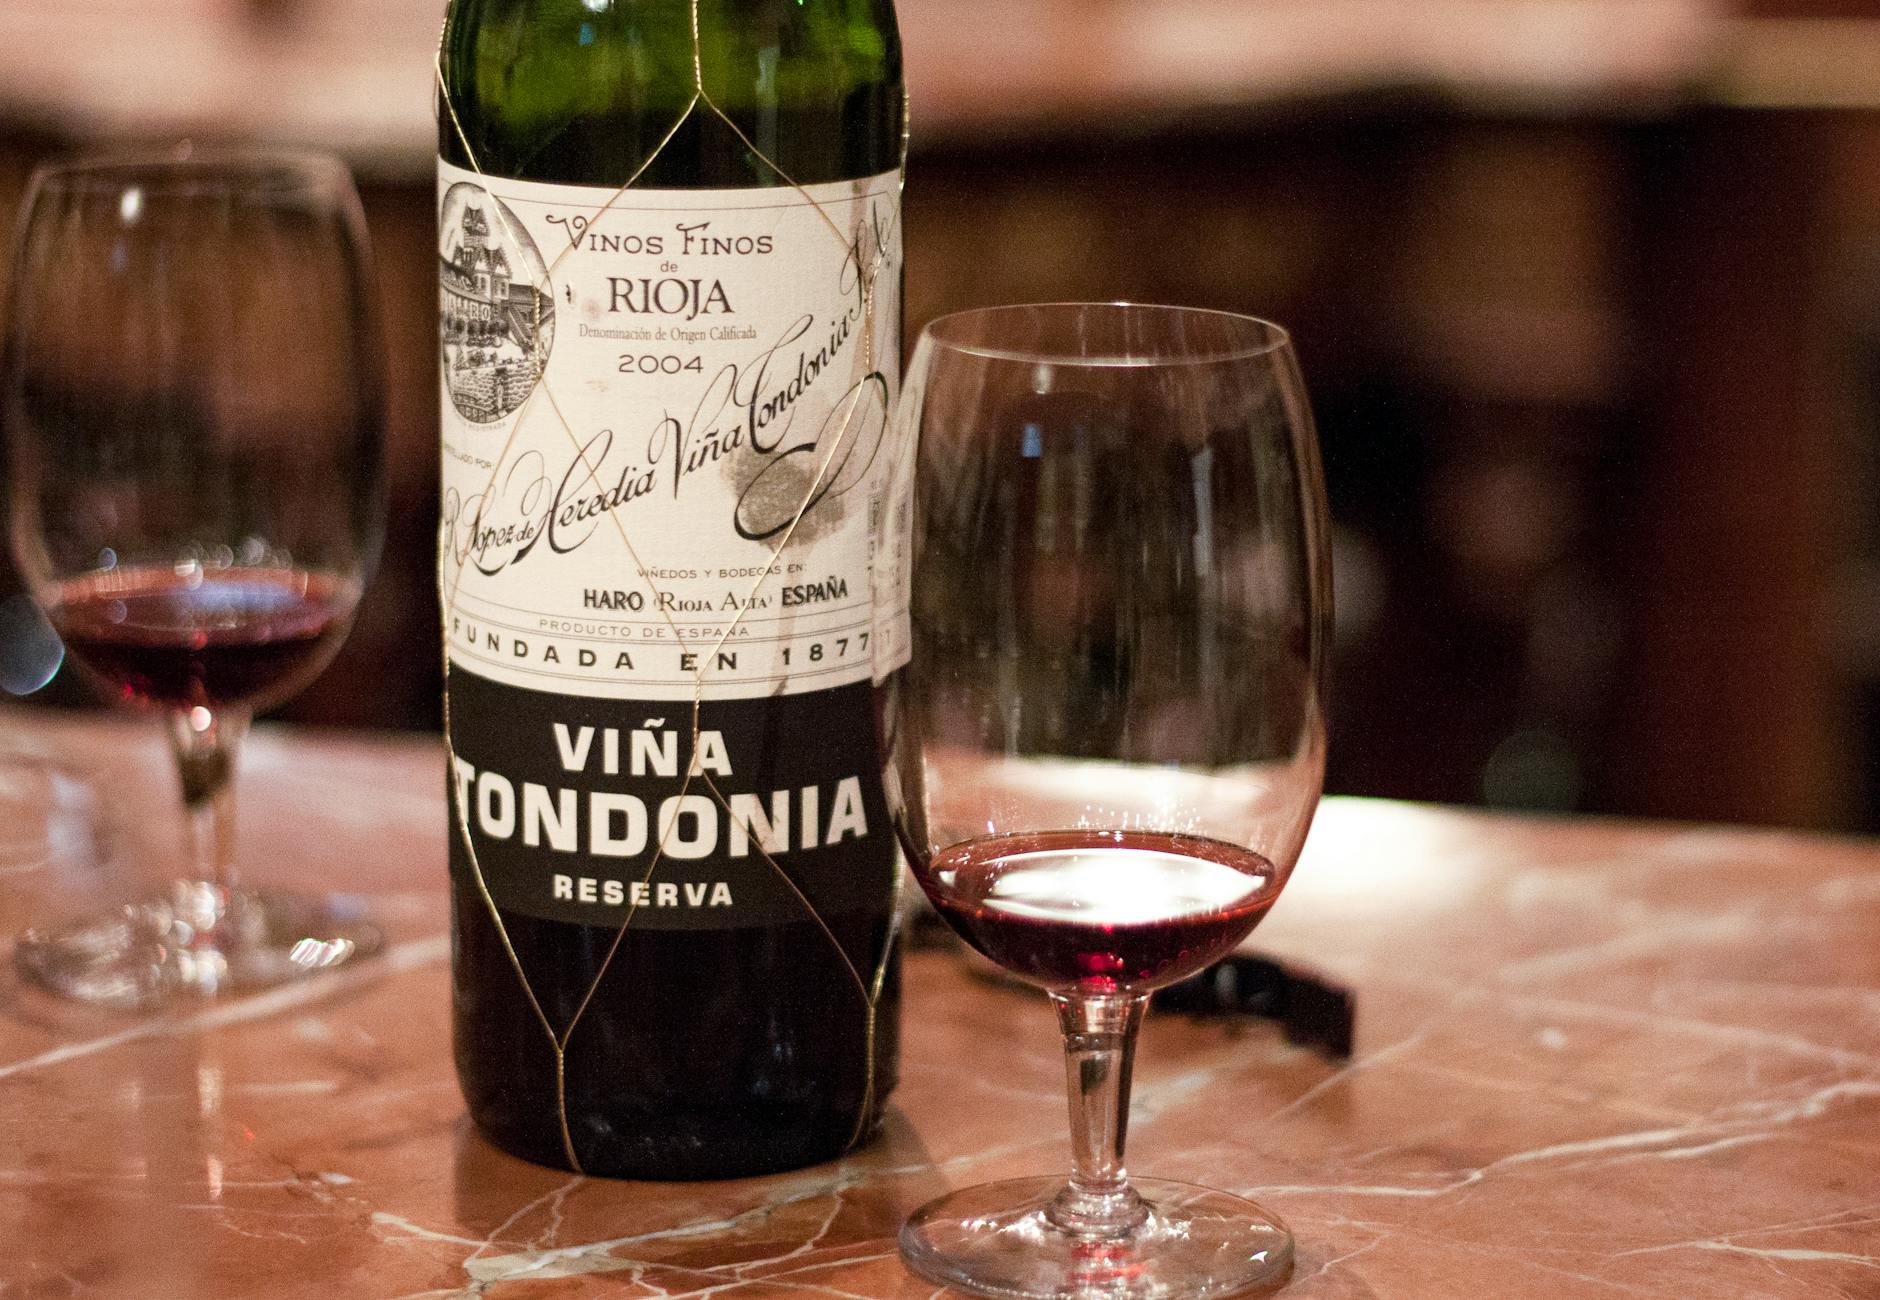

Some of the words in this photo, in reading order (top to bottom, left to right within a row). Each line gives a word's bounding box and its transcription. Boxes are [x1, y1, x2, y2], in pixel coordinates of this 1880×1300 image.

[546, 215, 663, 255] VINOS
[676, 222, 773, 255] FINOS
[660, 261, 678, 273] de
[606, 276, 735, 321] RIOJA
[579, 323, 651, 341] Denominación
[655, 326, 667, 340] de
[670, 327, 706, 345] Origen
[709, 324, 757, 340] Calificada
[618, 354, 704, 375] 2004
[648, 363, 744, 500] Viña
[703, 569, 713, 579] Y
[719, 565, 782, 579] BODEGAS
[583, 588, 644, 612] HARO
[782, 576, 849, 607] ESPAÑA
[454, 617, 635, 670] FUNDADA
[680, 651, 738, 672] EN
[782, 632, 870, 666] 1877
[539, 618, 632, 637] PRODUCTO
[643, 627, 666, 639] DE
[553, 717, 733, 777] VIÑA
[455, 755, 868, 861] TONDONIA
[552, 873, 733, 907] RESERVA
